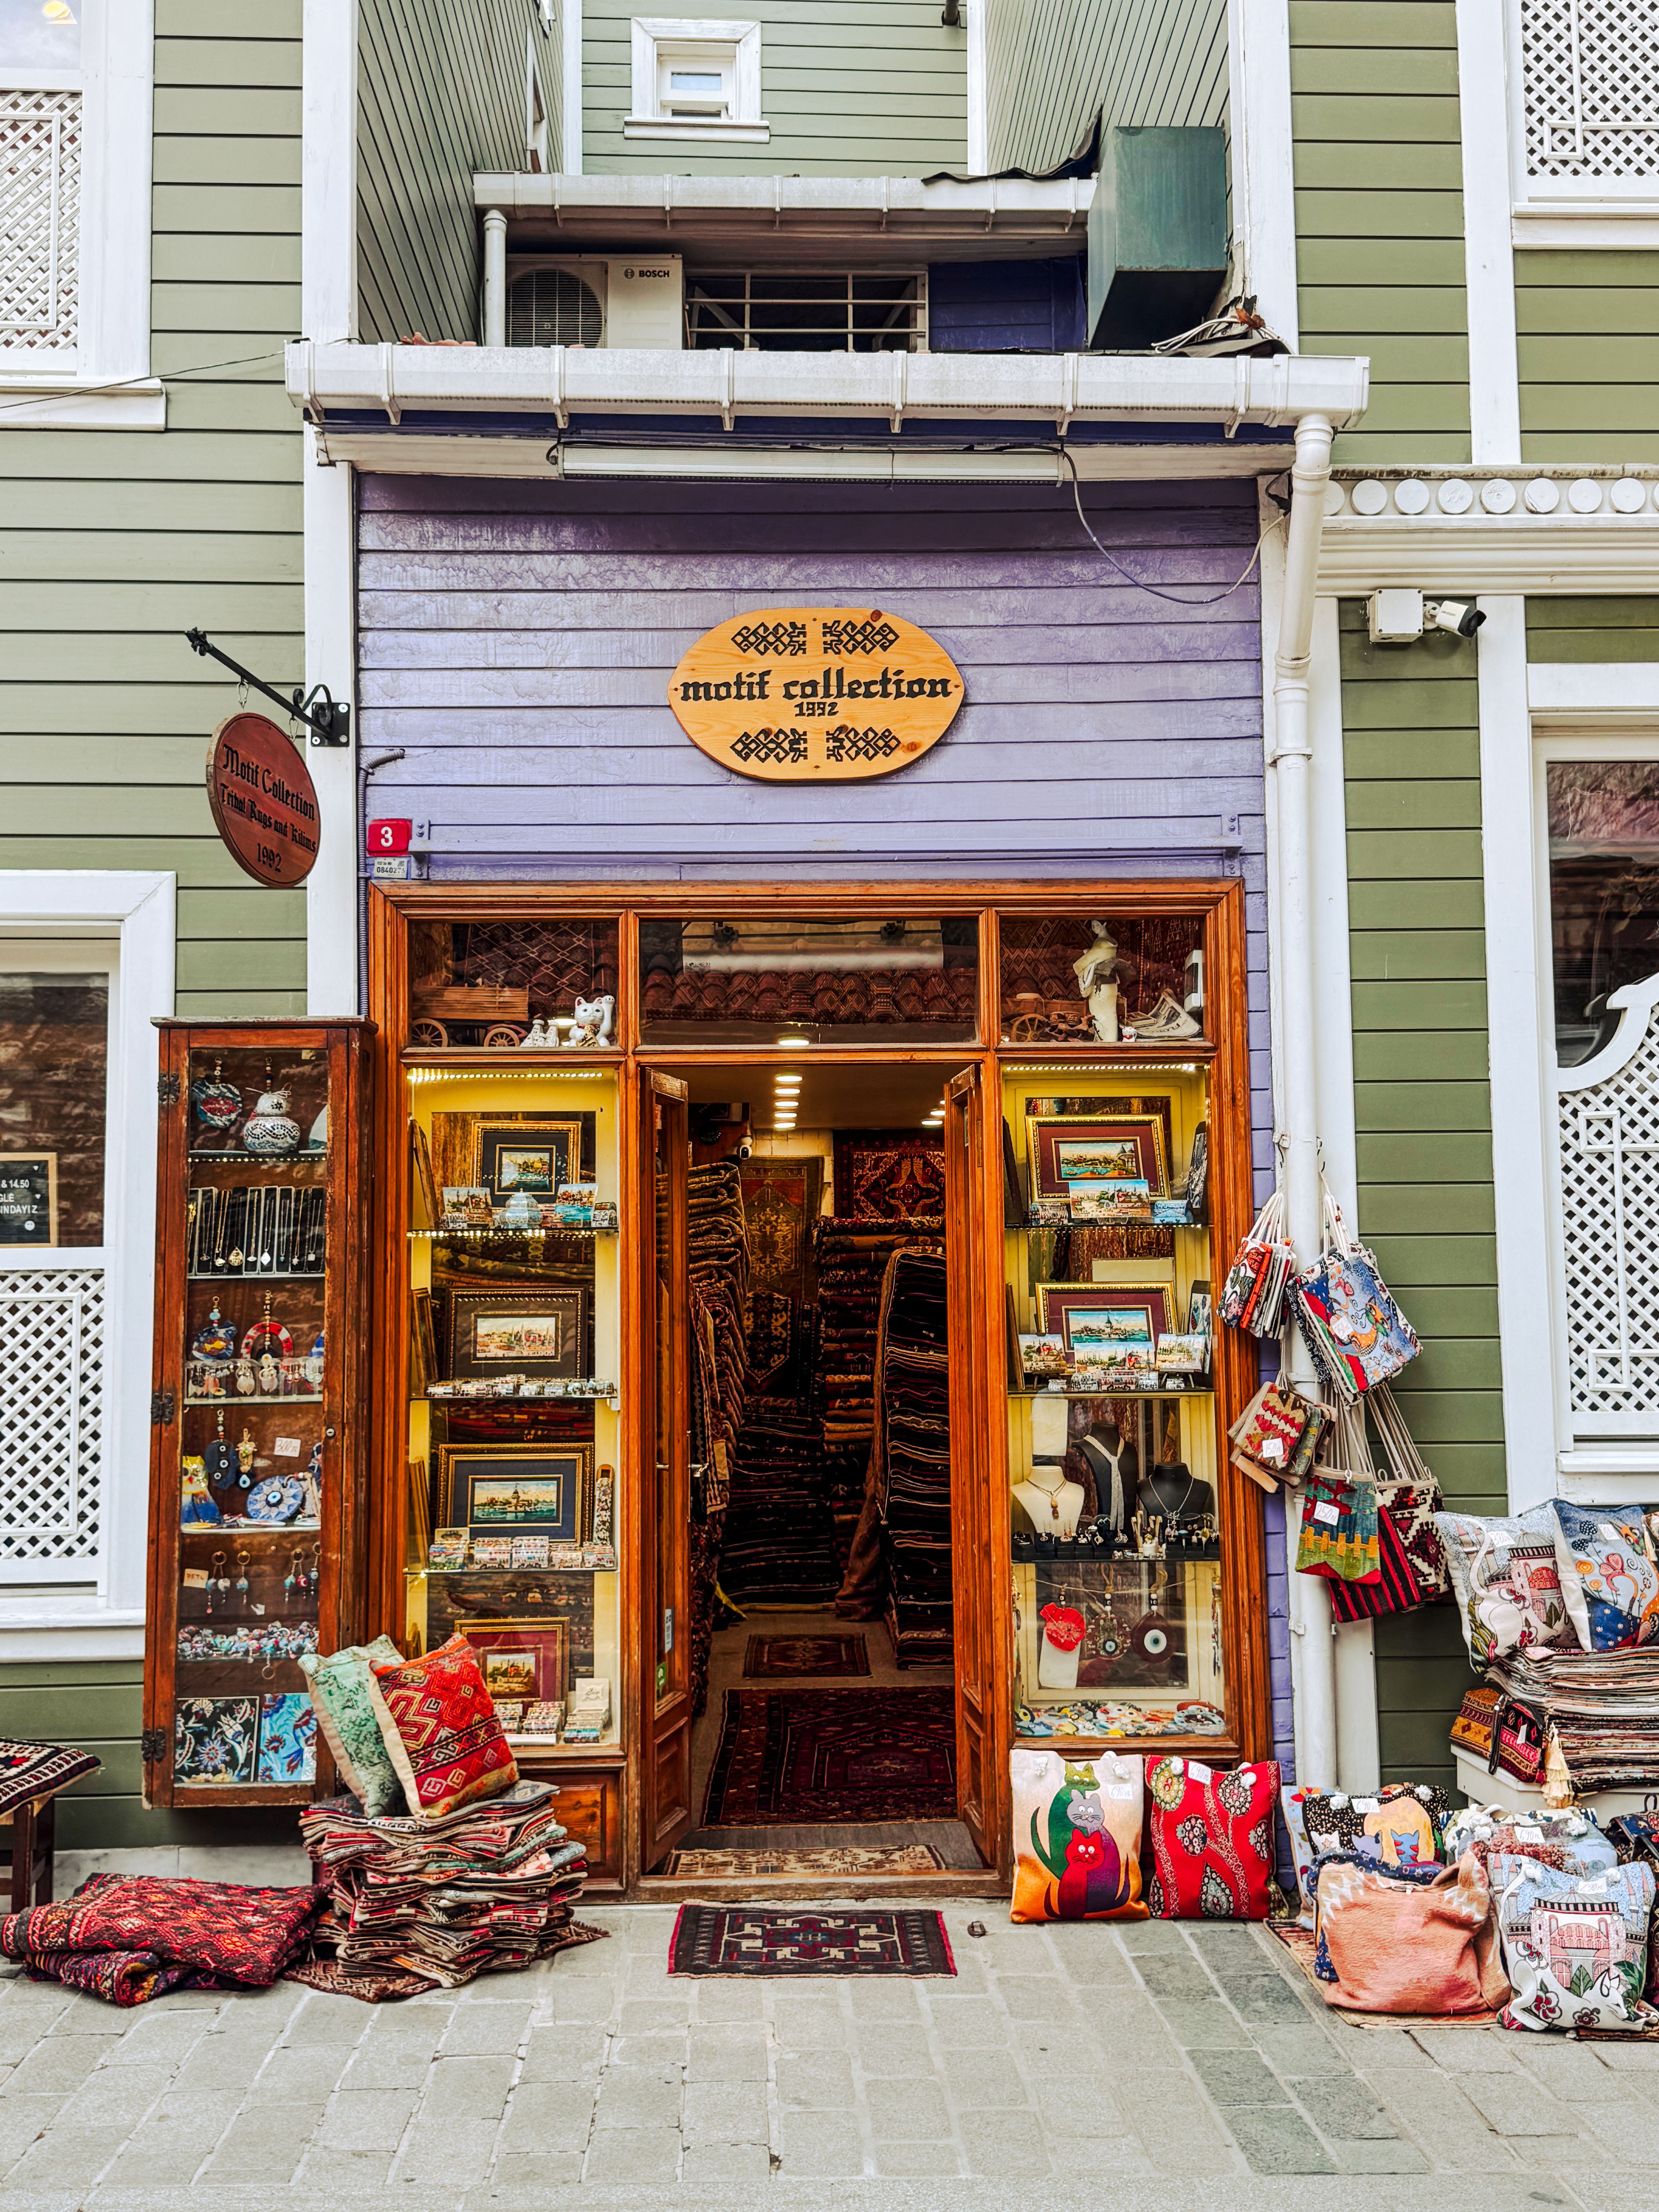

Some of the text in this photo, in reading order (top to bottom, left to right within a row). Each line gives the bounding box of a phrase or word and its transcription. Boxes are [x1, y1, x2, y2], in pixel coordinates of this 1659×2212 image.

[680, 667, 953, 701] motif collection
[794, 702, 839, 717] 1992
[222, 743, 315, 821] Motif Collection
[220, 783, 316, 853] Tribal Rugs and Kilims
[381, 826, 393, 847] 3
[257, 843, 282, 873] 1992
[0, 1204, 38, 1214] INDAYIZ
